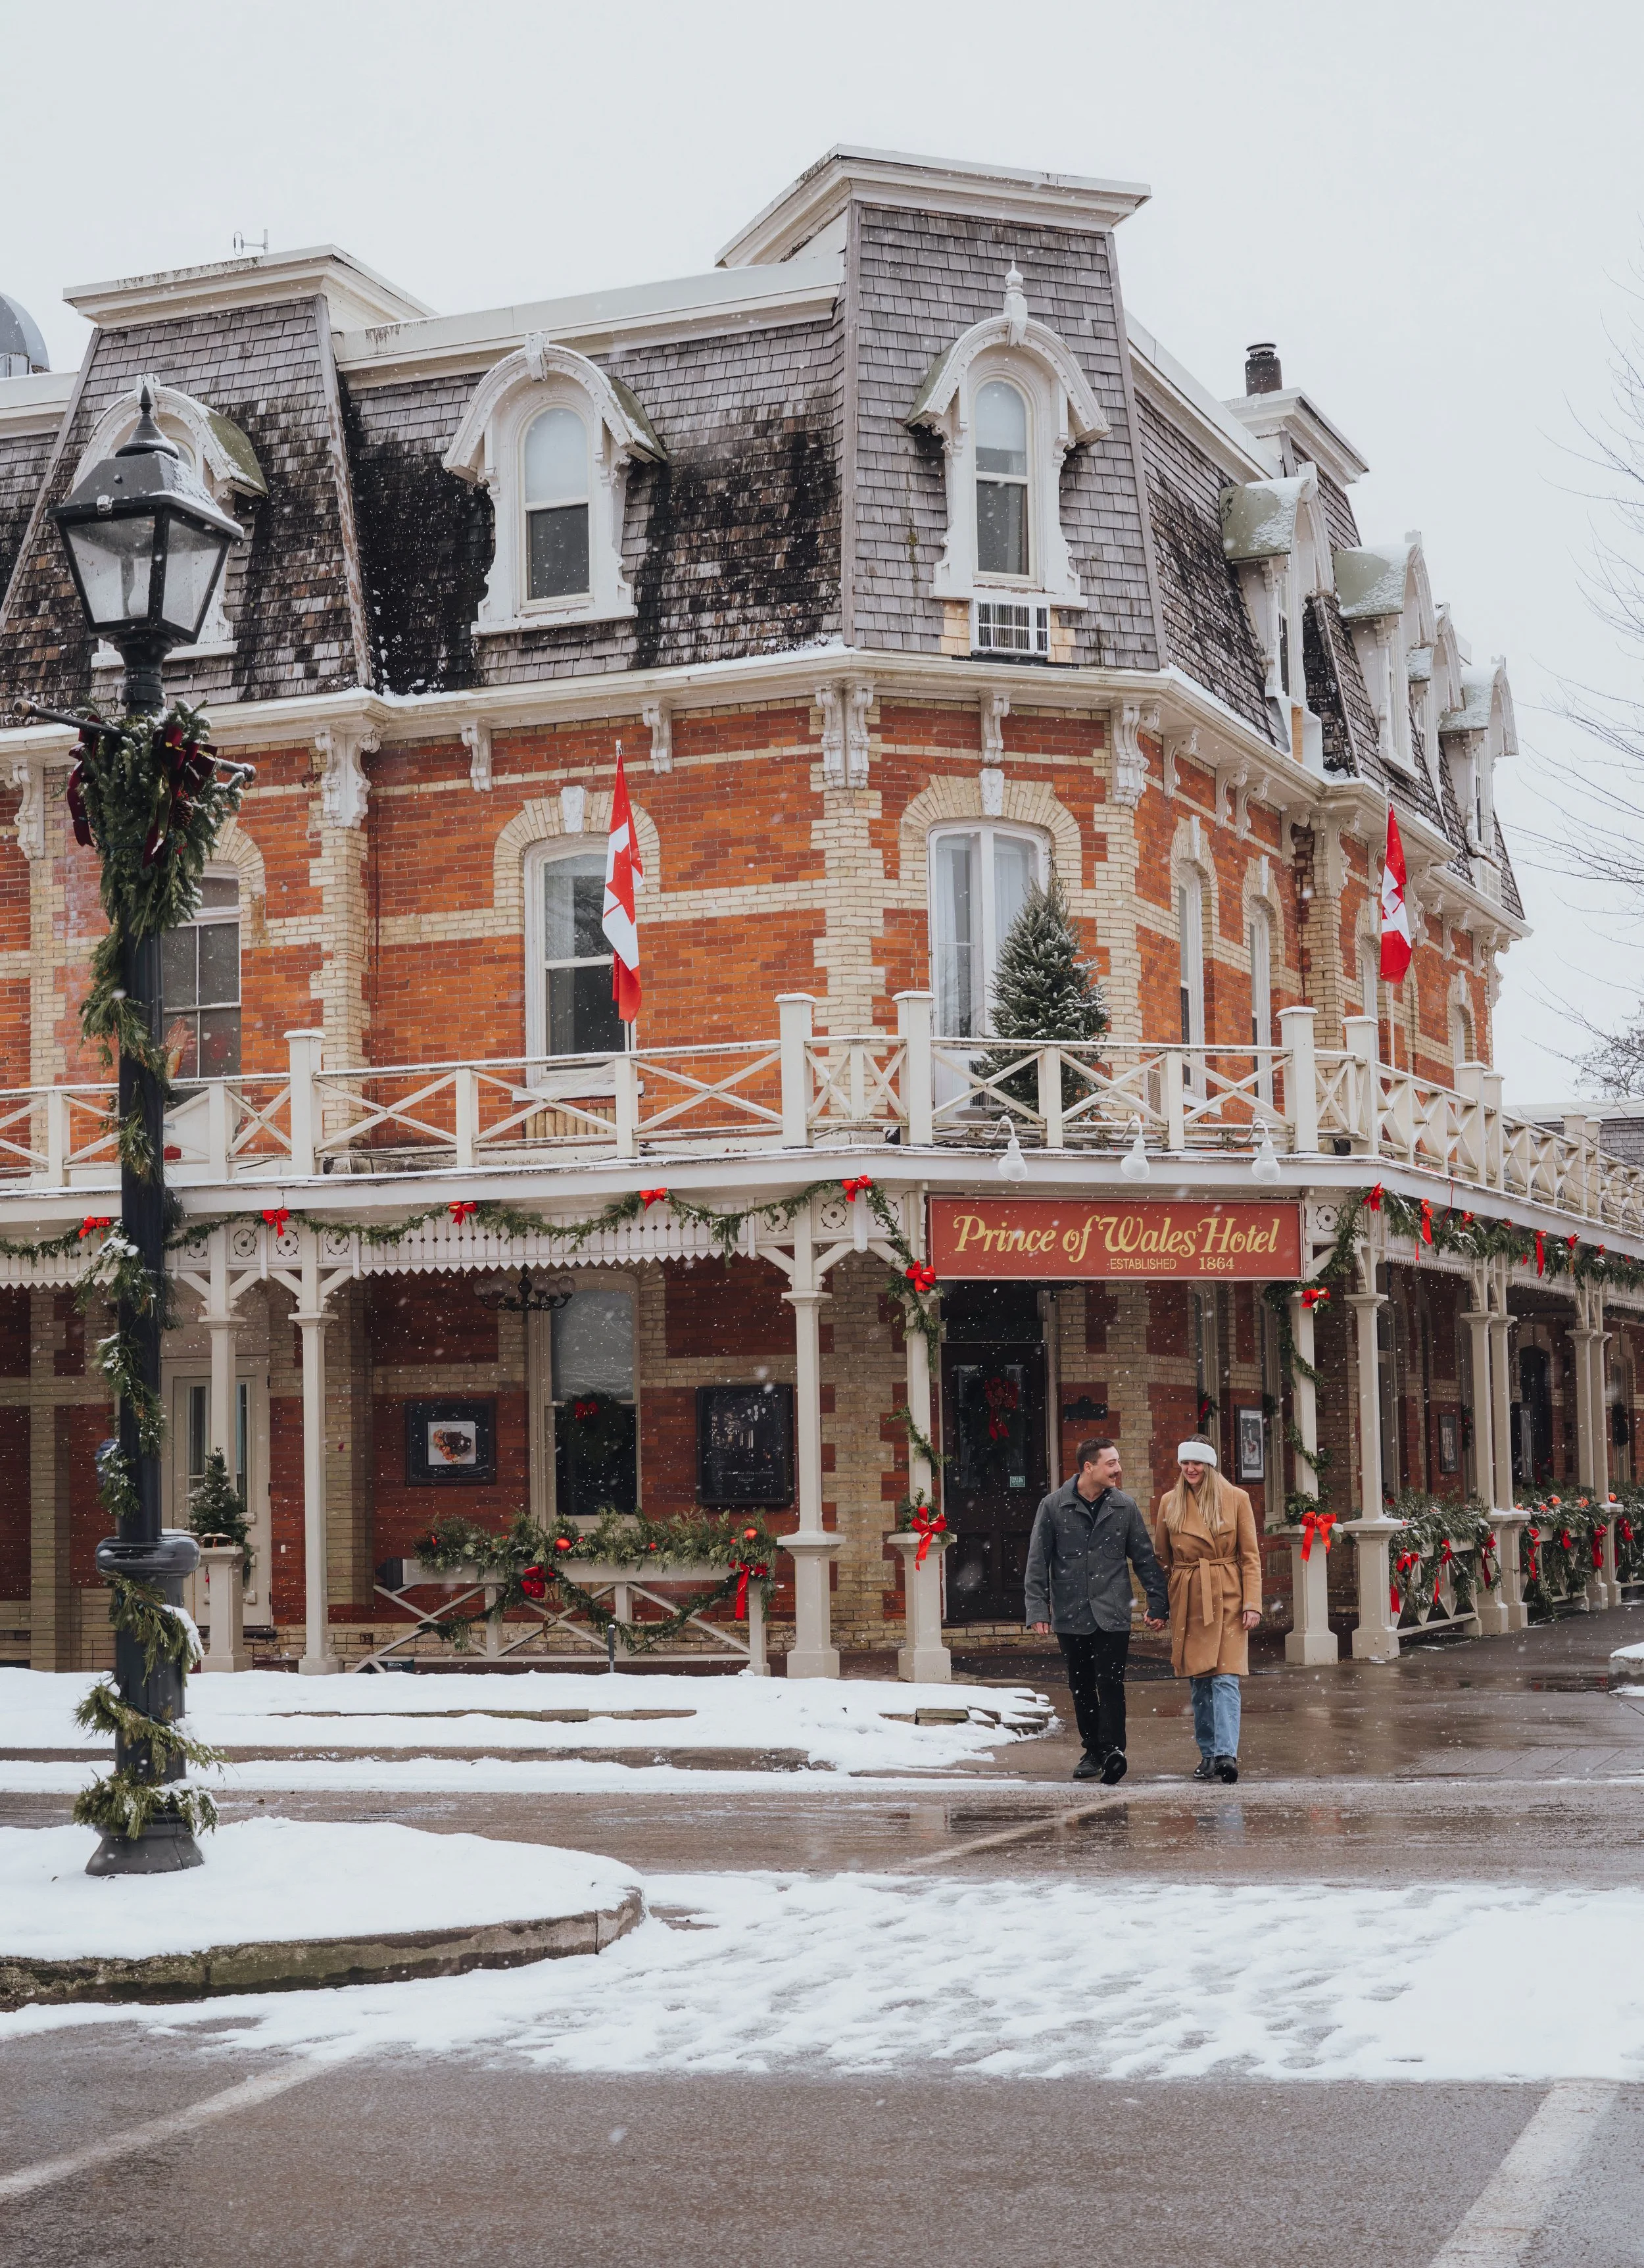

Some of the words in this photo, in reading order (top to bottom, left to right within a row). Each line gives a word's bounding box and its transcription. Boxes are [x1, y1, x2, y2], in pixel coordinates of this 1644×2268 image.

[953, 1216, 1056, 1252] Prince
[1061, 1214, 1100, 1262] of
[1099, 1216, 1197, 1258] Wales
[1197, 1218, 1280, 1253] Hotel
[1110, 1258, 1176, 1270] ESTABLISHED
[1198, 1257, 1234, 1270] 1864
